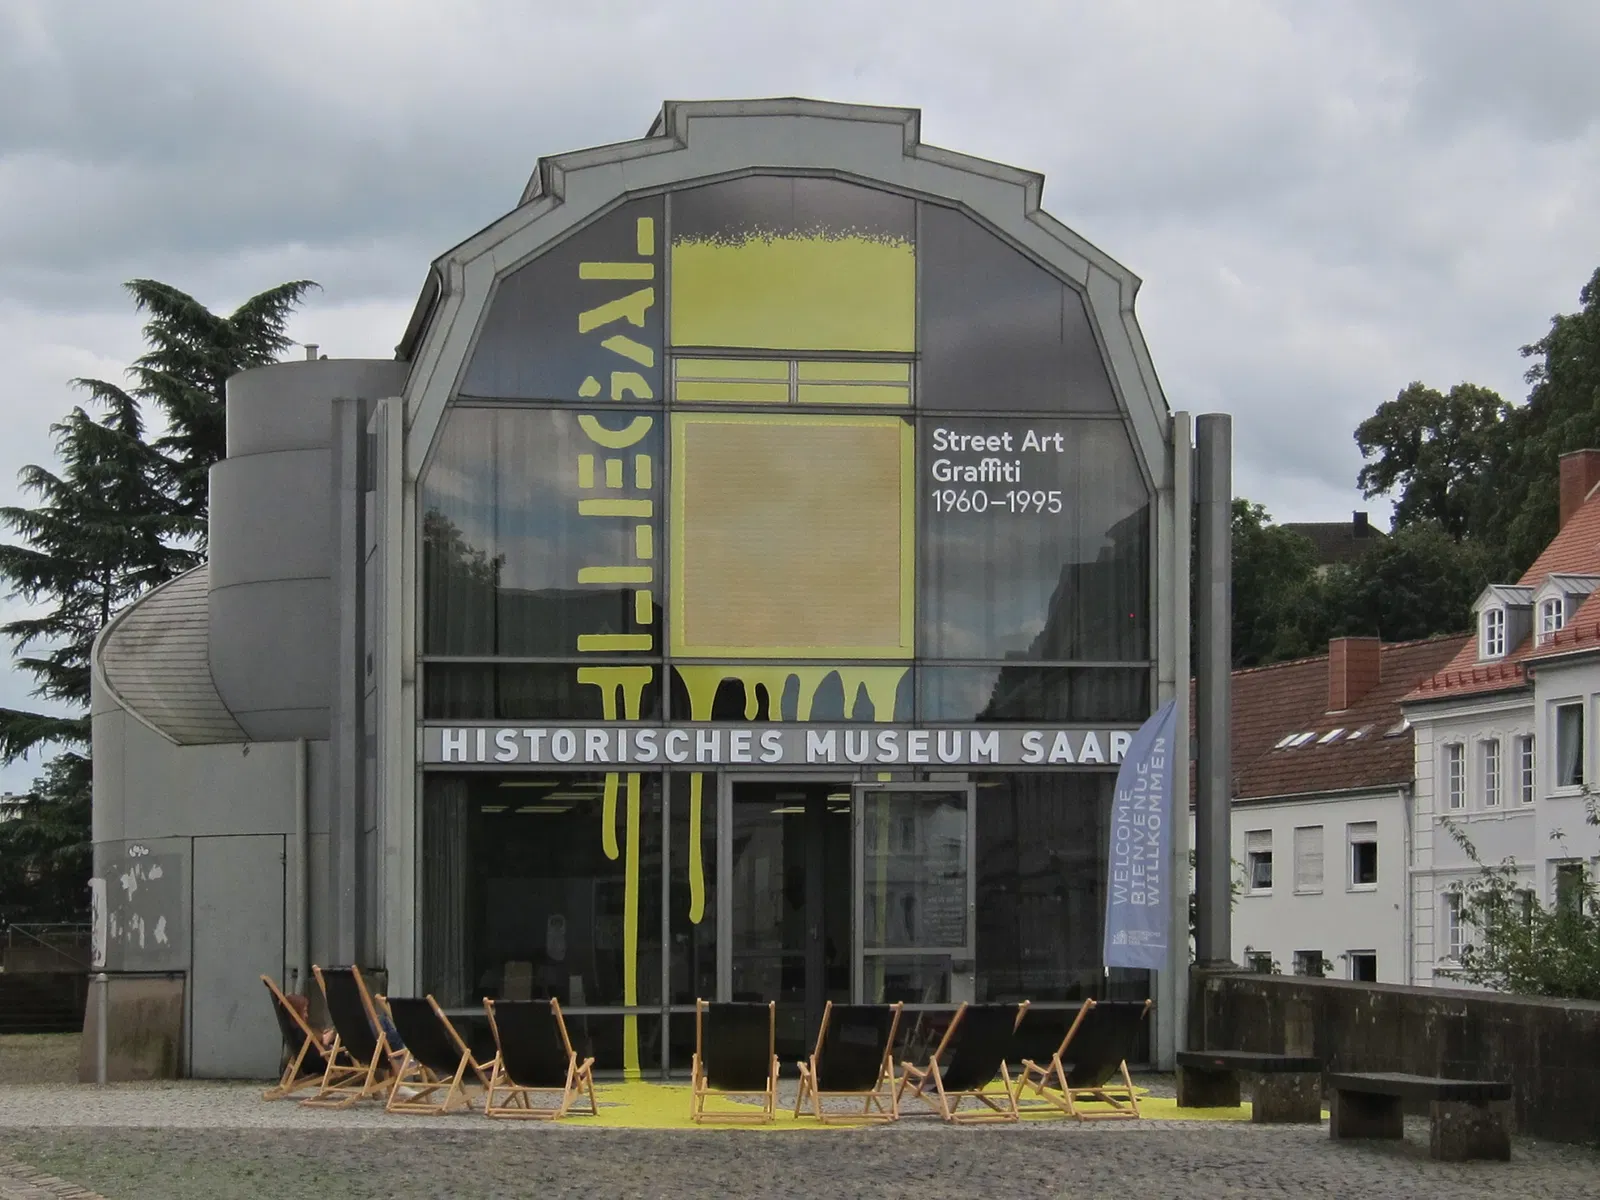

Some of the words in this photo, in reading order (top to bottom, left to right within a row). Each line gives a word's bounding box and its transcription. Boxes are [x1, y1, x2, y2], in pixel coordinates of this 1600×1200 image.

[575, 216, 655, 690] ILLEGAL
[931, 457, 1021, 483] Graffiti
[932, 427, 1013, 452] Street
[1020, 429, 1065, 453] Art
[931, 489, 1063, 514] 1960–1995
[441, 728, 784, 763] HISTORISCHES
[806, 730, 1000, 764] MUSEUM
[1020, 730, 1133, 764] SAAR
[1112, 788, 1133, 906] WELCOME
[1130, 761, 1149, 906] BIENVENUE
[1147, 736, 1167, 908] WILLKOMMEN
